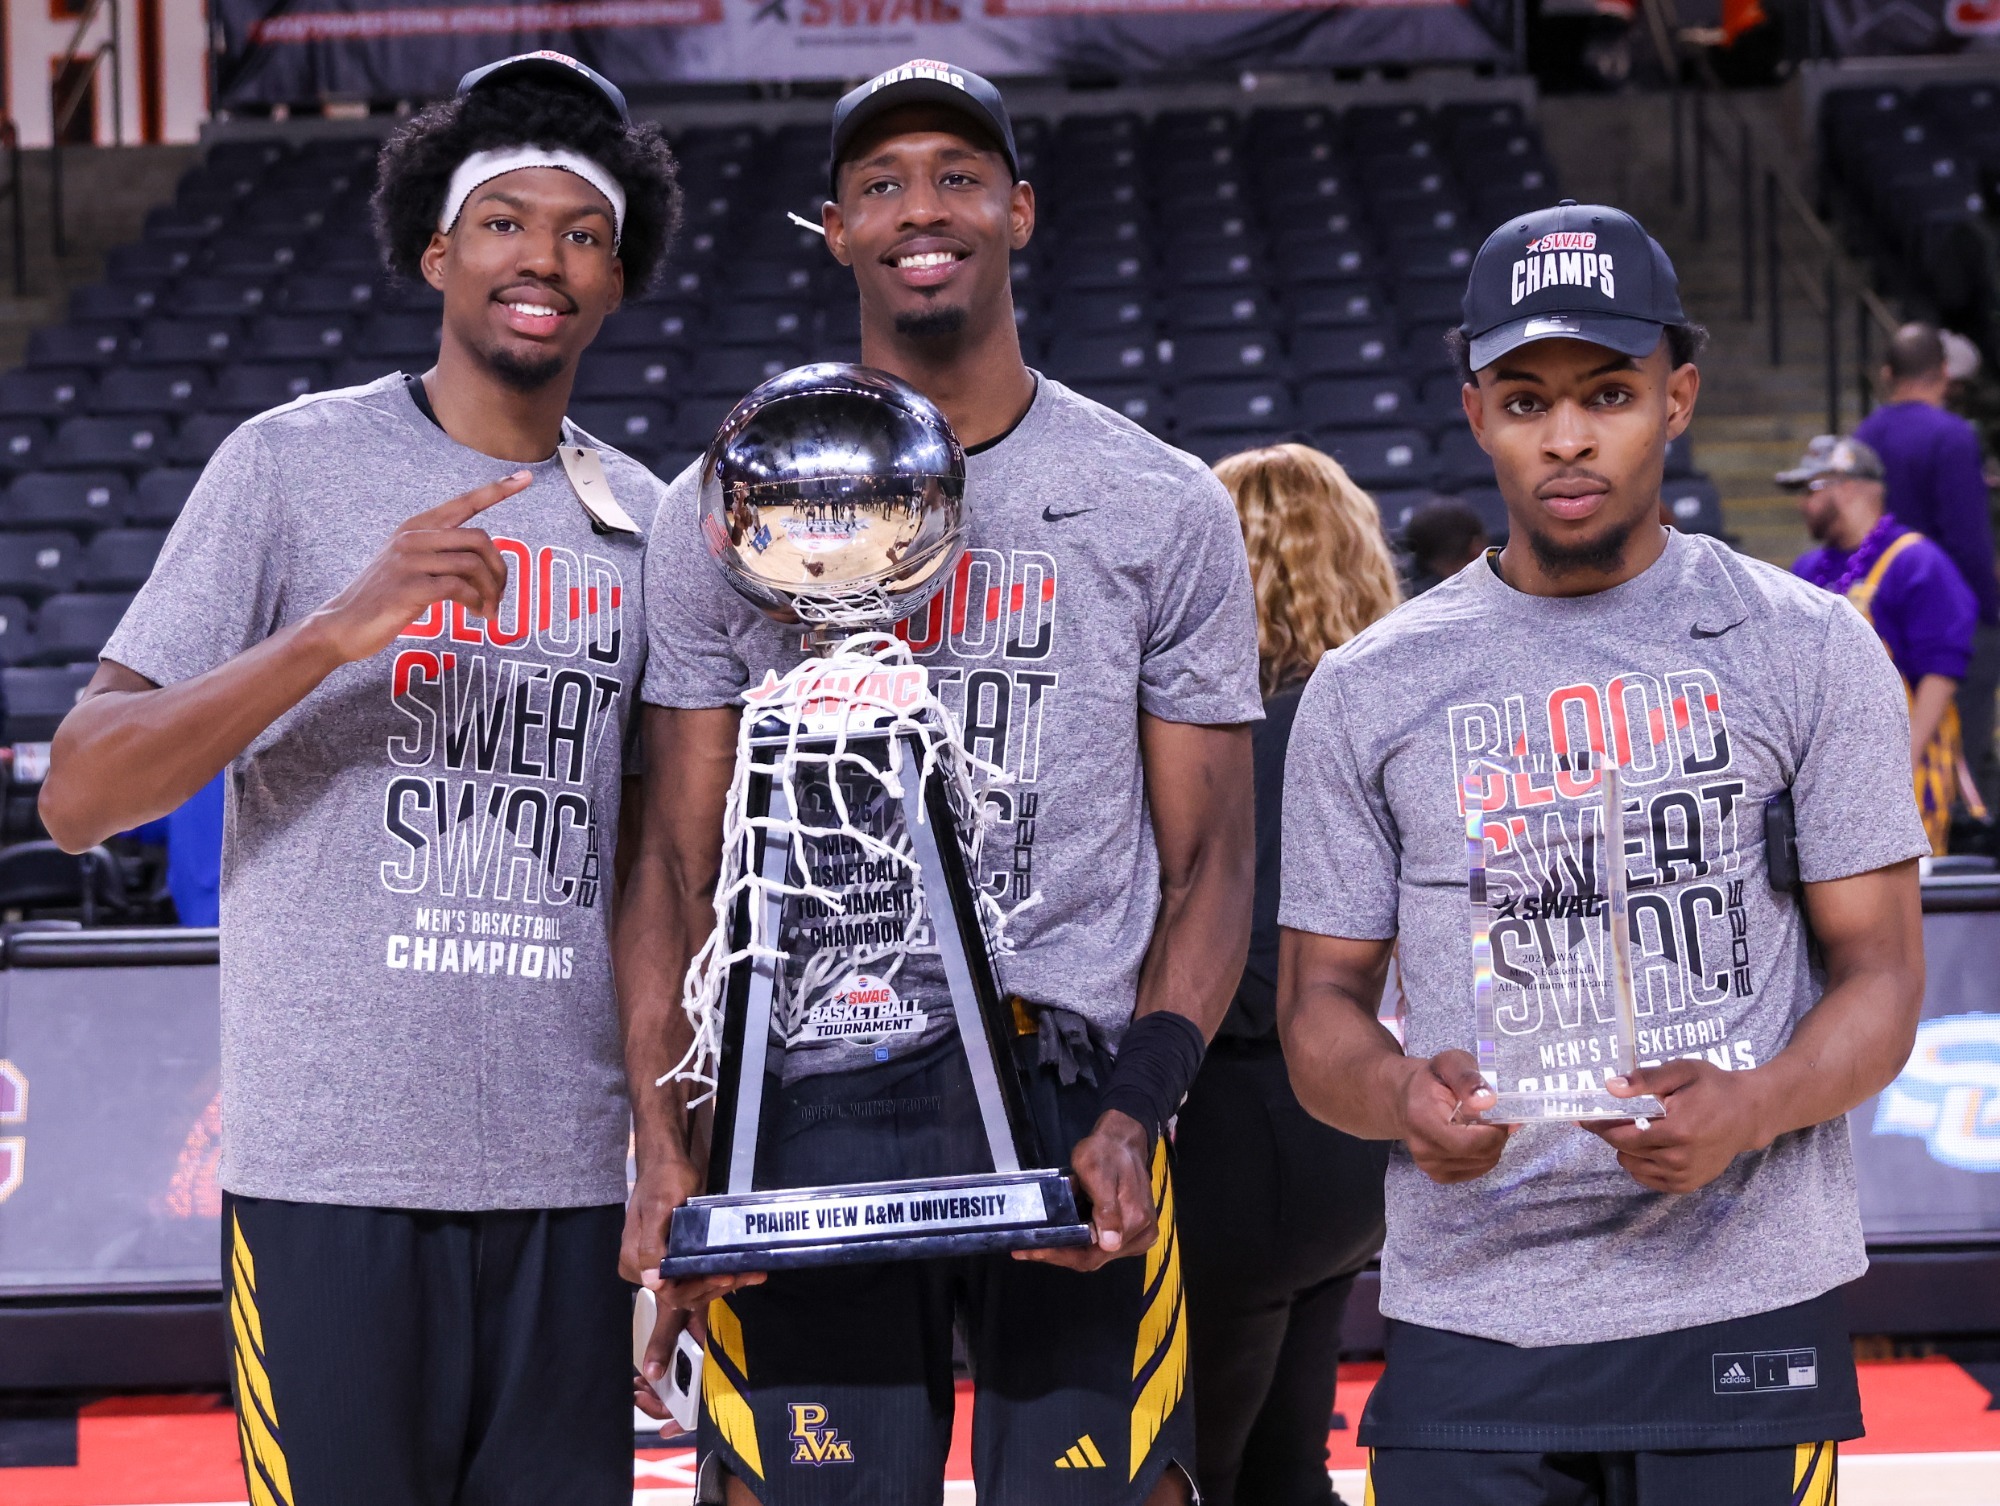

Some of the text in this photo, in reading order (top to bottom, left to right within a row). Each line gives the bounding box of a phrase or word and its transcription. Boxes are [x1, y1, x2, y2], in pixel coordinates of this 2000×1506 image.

[1541, 232, 1597, 250] SWAC
[1512, 252, 1615, 305] CHAMPS
[388, 650, 621, 784] SWEAT
[1448, 668, 1733, 816] BLOOD
[381, 776, 588, 905] SWAC
[808, 857, 909, 888] ASKETBALL
[1522, 893, 1604, 920] SWAC
[416, 907, 561, 941] MEN'S BASKETBALL
[810, 920, 905, 948] CHAMPION
[1727, 879, 1753, 998] 2026
[386, 934, 574, 980] CHAMPIONS
[808, 999, 924, 1024] BASKETBALL
[849, 989, 891, 1005] SWAC
[816, 1018, 913, 1037] TOURNAMENT
[1539, 1016, 1728, 1070] MEN'S BSKETBALL
[745, 1193, 1007, 1235] PRAIRIE VIEW A&M UNIVERSITY
[1720, 1375, 1751, 1384] adidas
